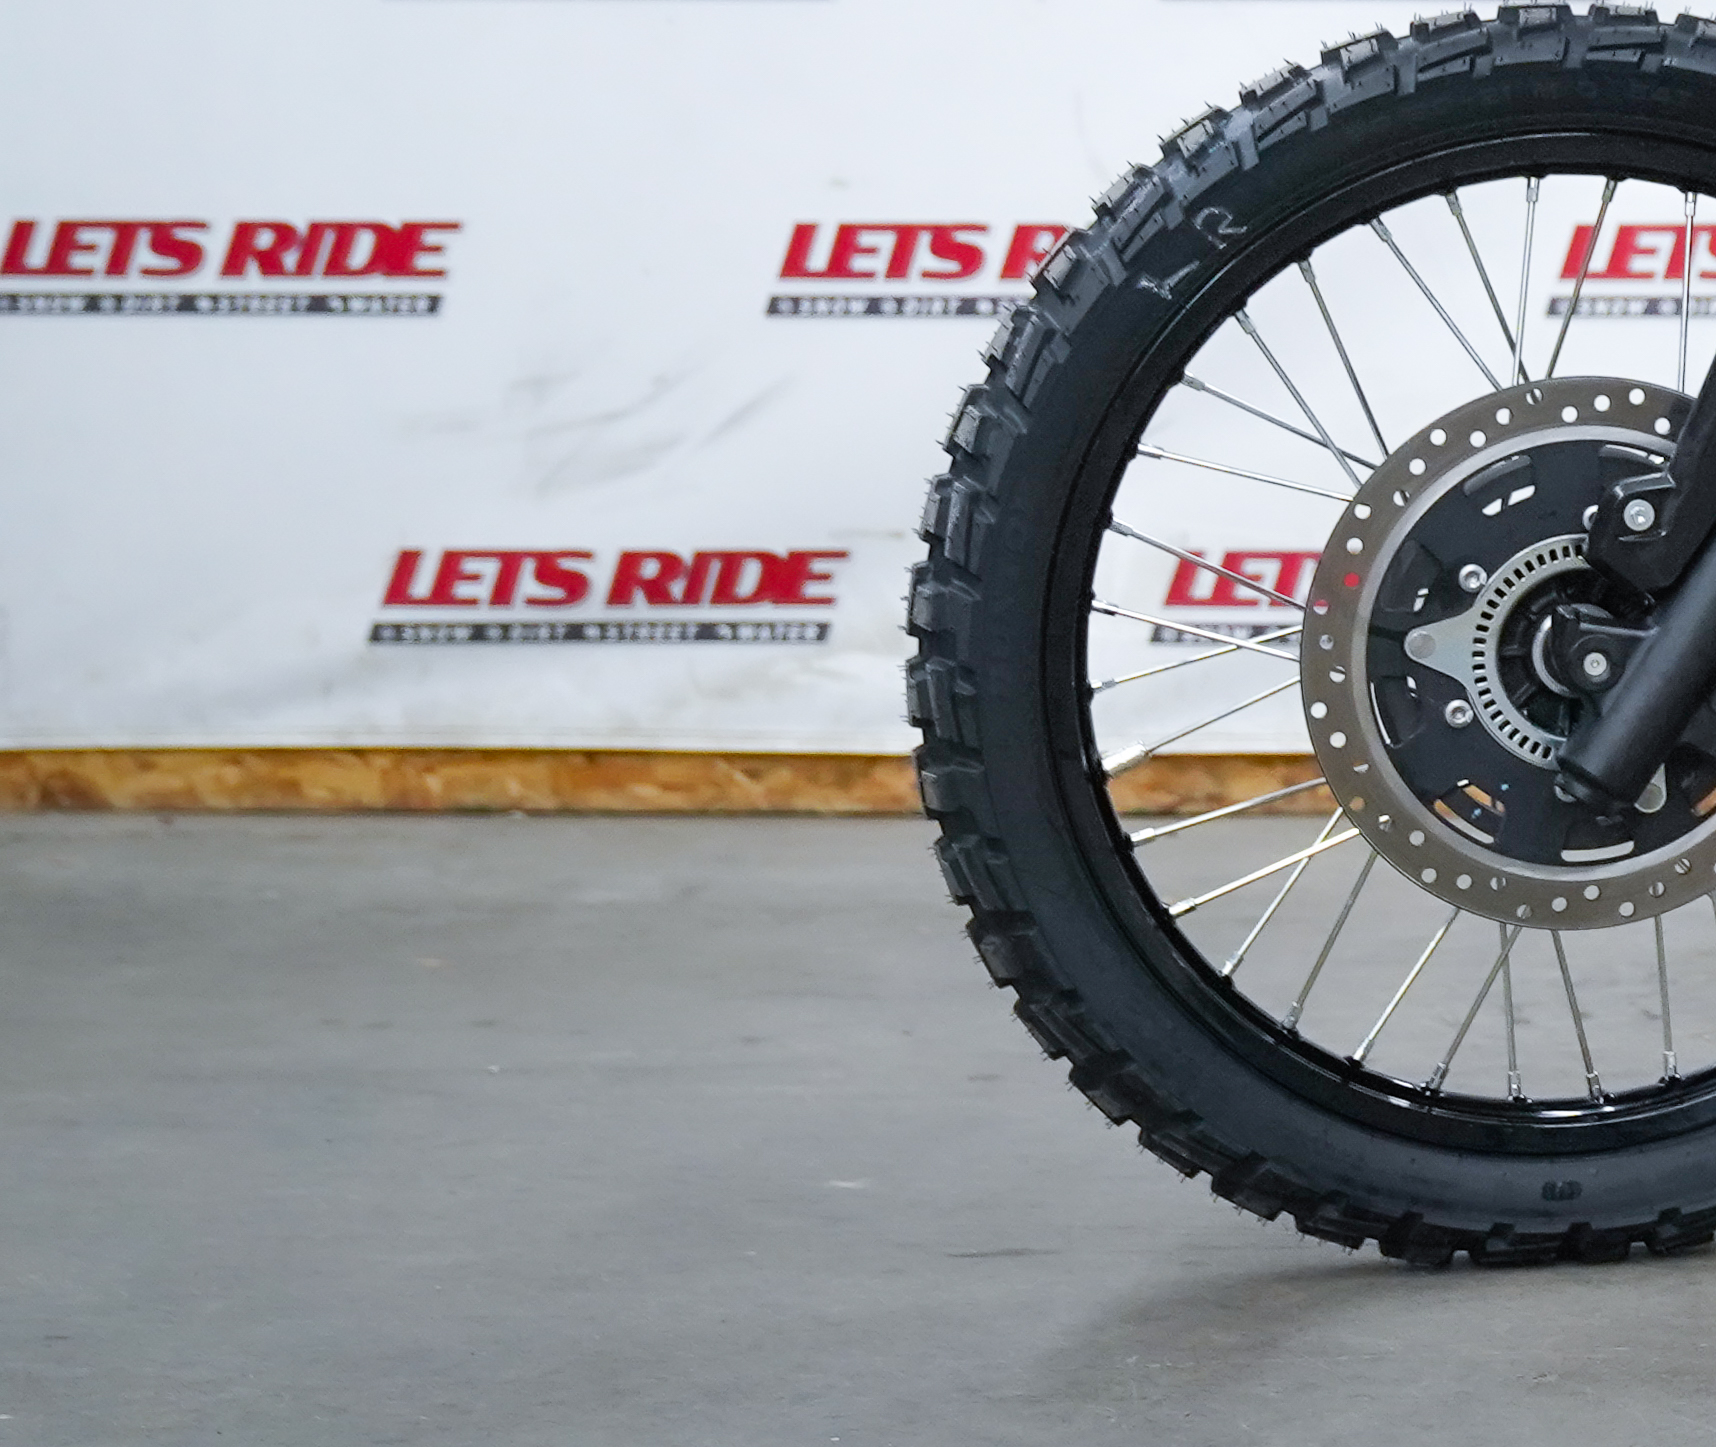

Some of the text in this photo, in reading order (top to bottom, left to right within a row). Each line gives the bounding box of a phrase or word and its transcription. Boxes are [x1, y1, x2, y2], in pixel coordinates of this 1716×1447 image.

[0, 221, 459, 277] LETS RIDE
[779, 223, 988, 279] LETS
[384, 550, 847, 606] LETS RIDE
[1165, 551, 1324, 607] LET
